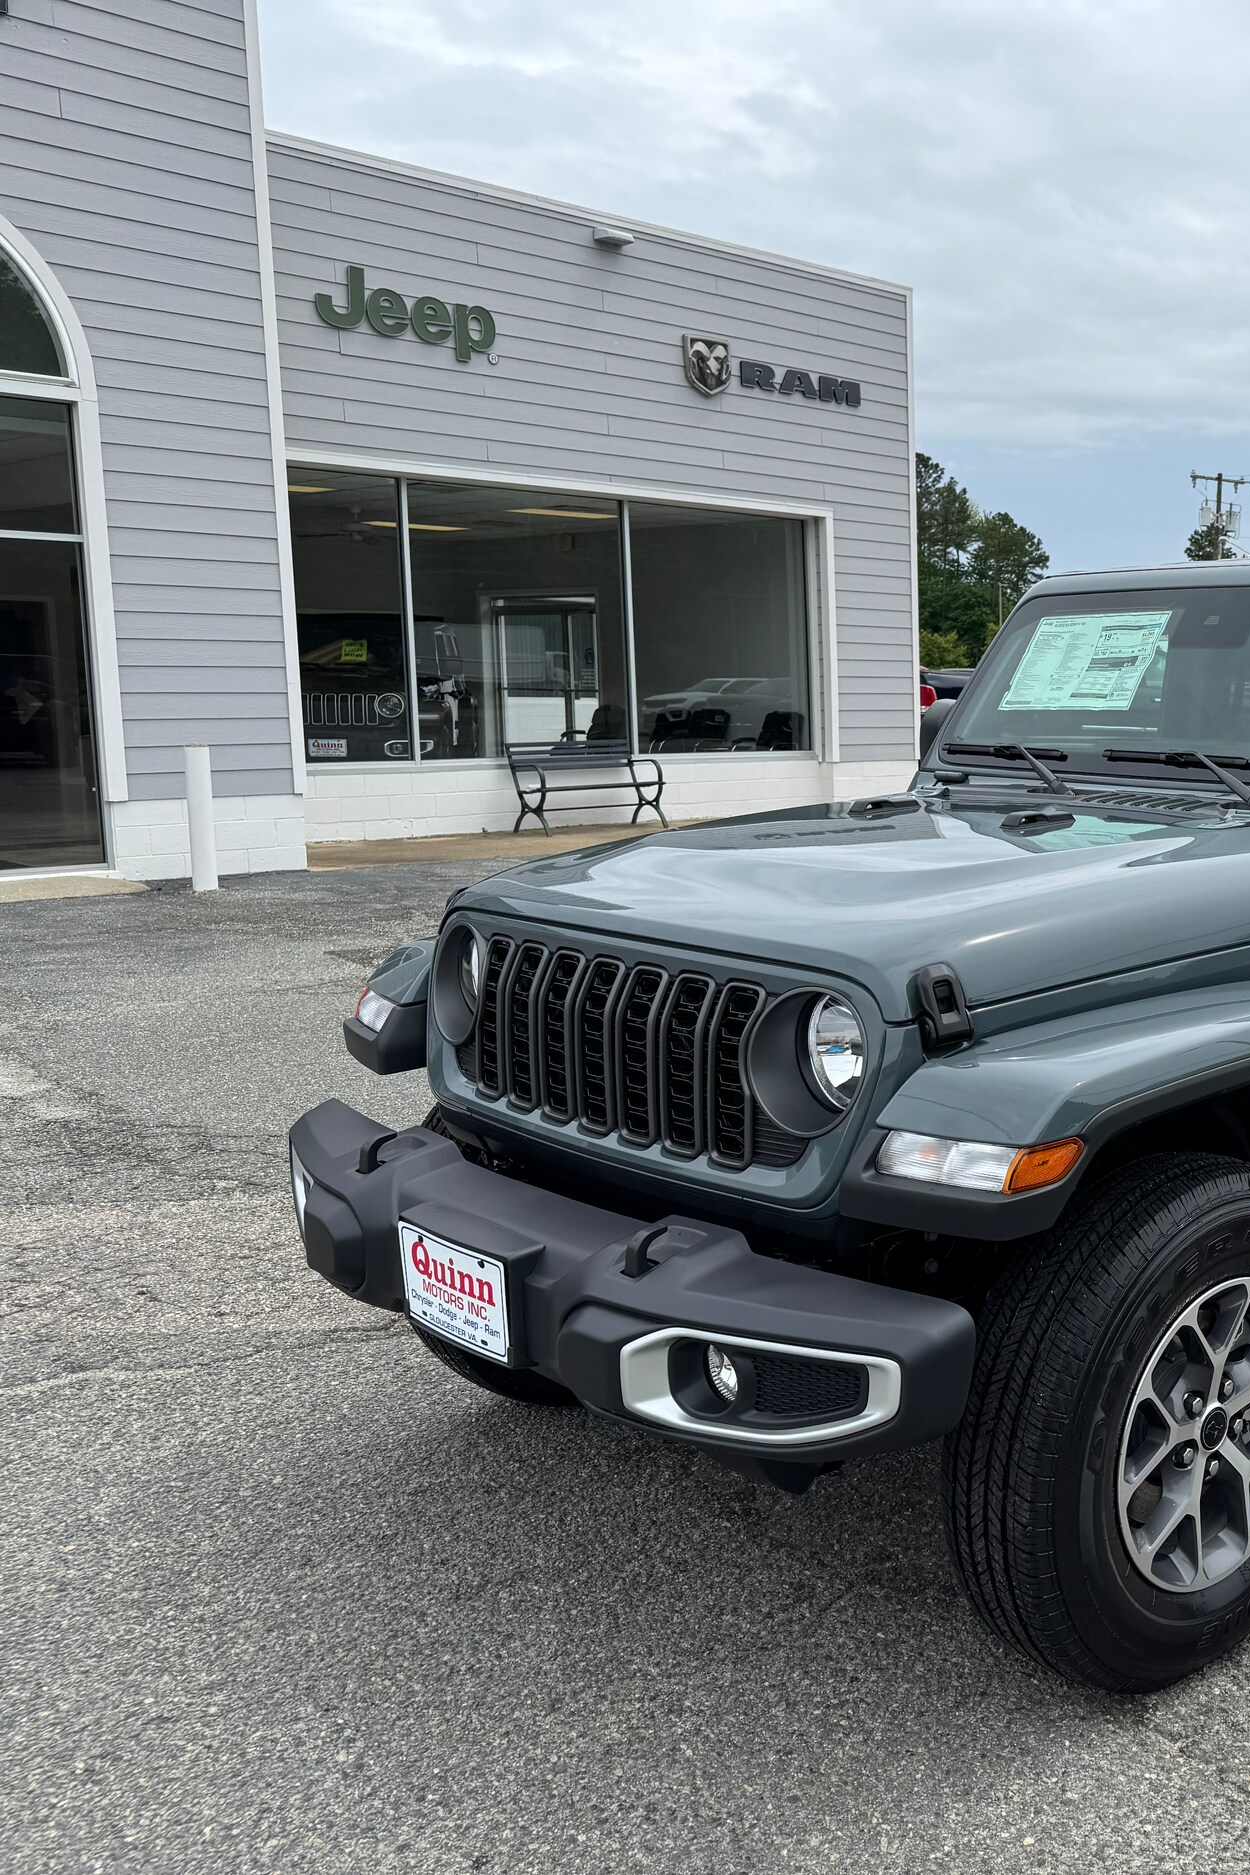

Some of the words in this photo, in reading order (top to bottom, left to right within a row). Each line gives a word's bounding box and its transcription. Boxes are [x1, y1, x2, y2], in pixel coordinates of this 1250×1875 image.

[314, 264, 497, 363] Jeep
[739, 359, 862, 408] RAM
[312, 740, 343, 748] Quinn
[411, 1241, 496, 1307] Quinn
[411, 1288, 435, 1309] Chrysler
[438, 1303, 458, 1321] Dodge
[462, 1315, 479, 1330] Jeep
[485, 1324, 501, 1339] Ram
[422, 1279, 465, 1311] MOTORS
[468, 1300, 491, 1322] INC.
[429, 1313, 466, 1338] GLOUCESTER
